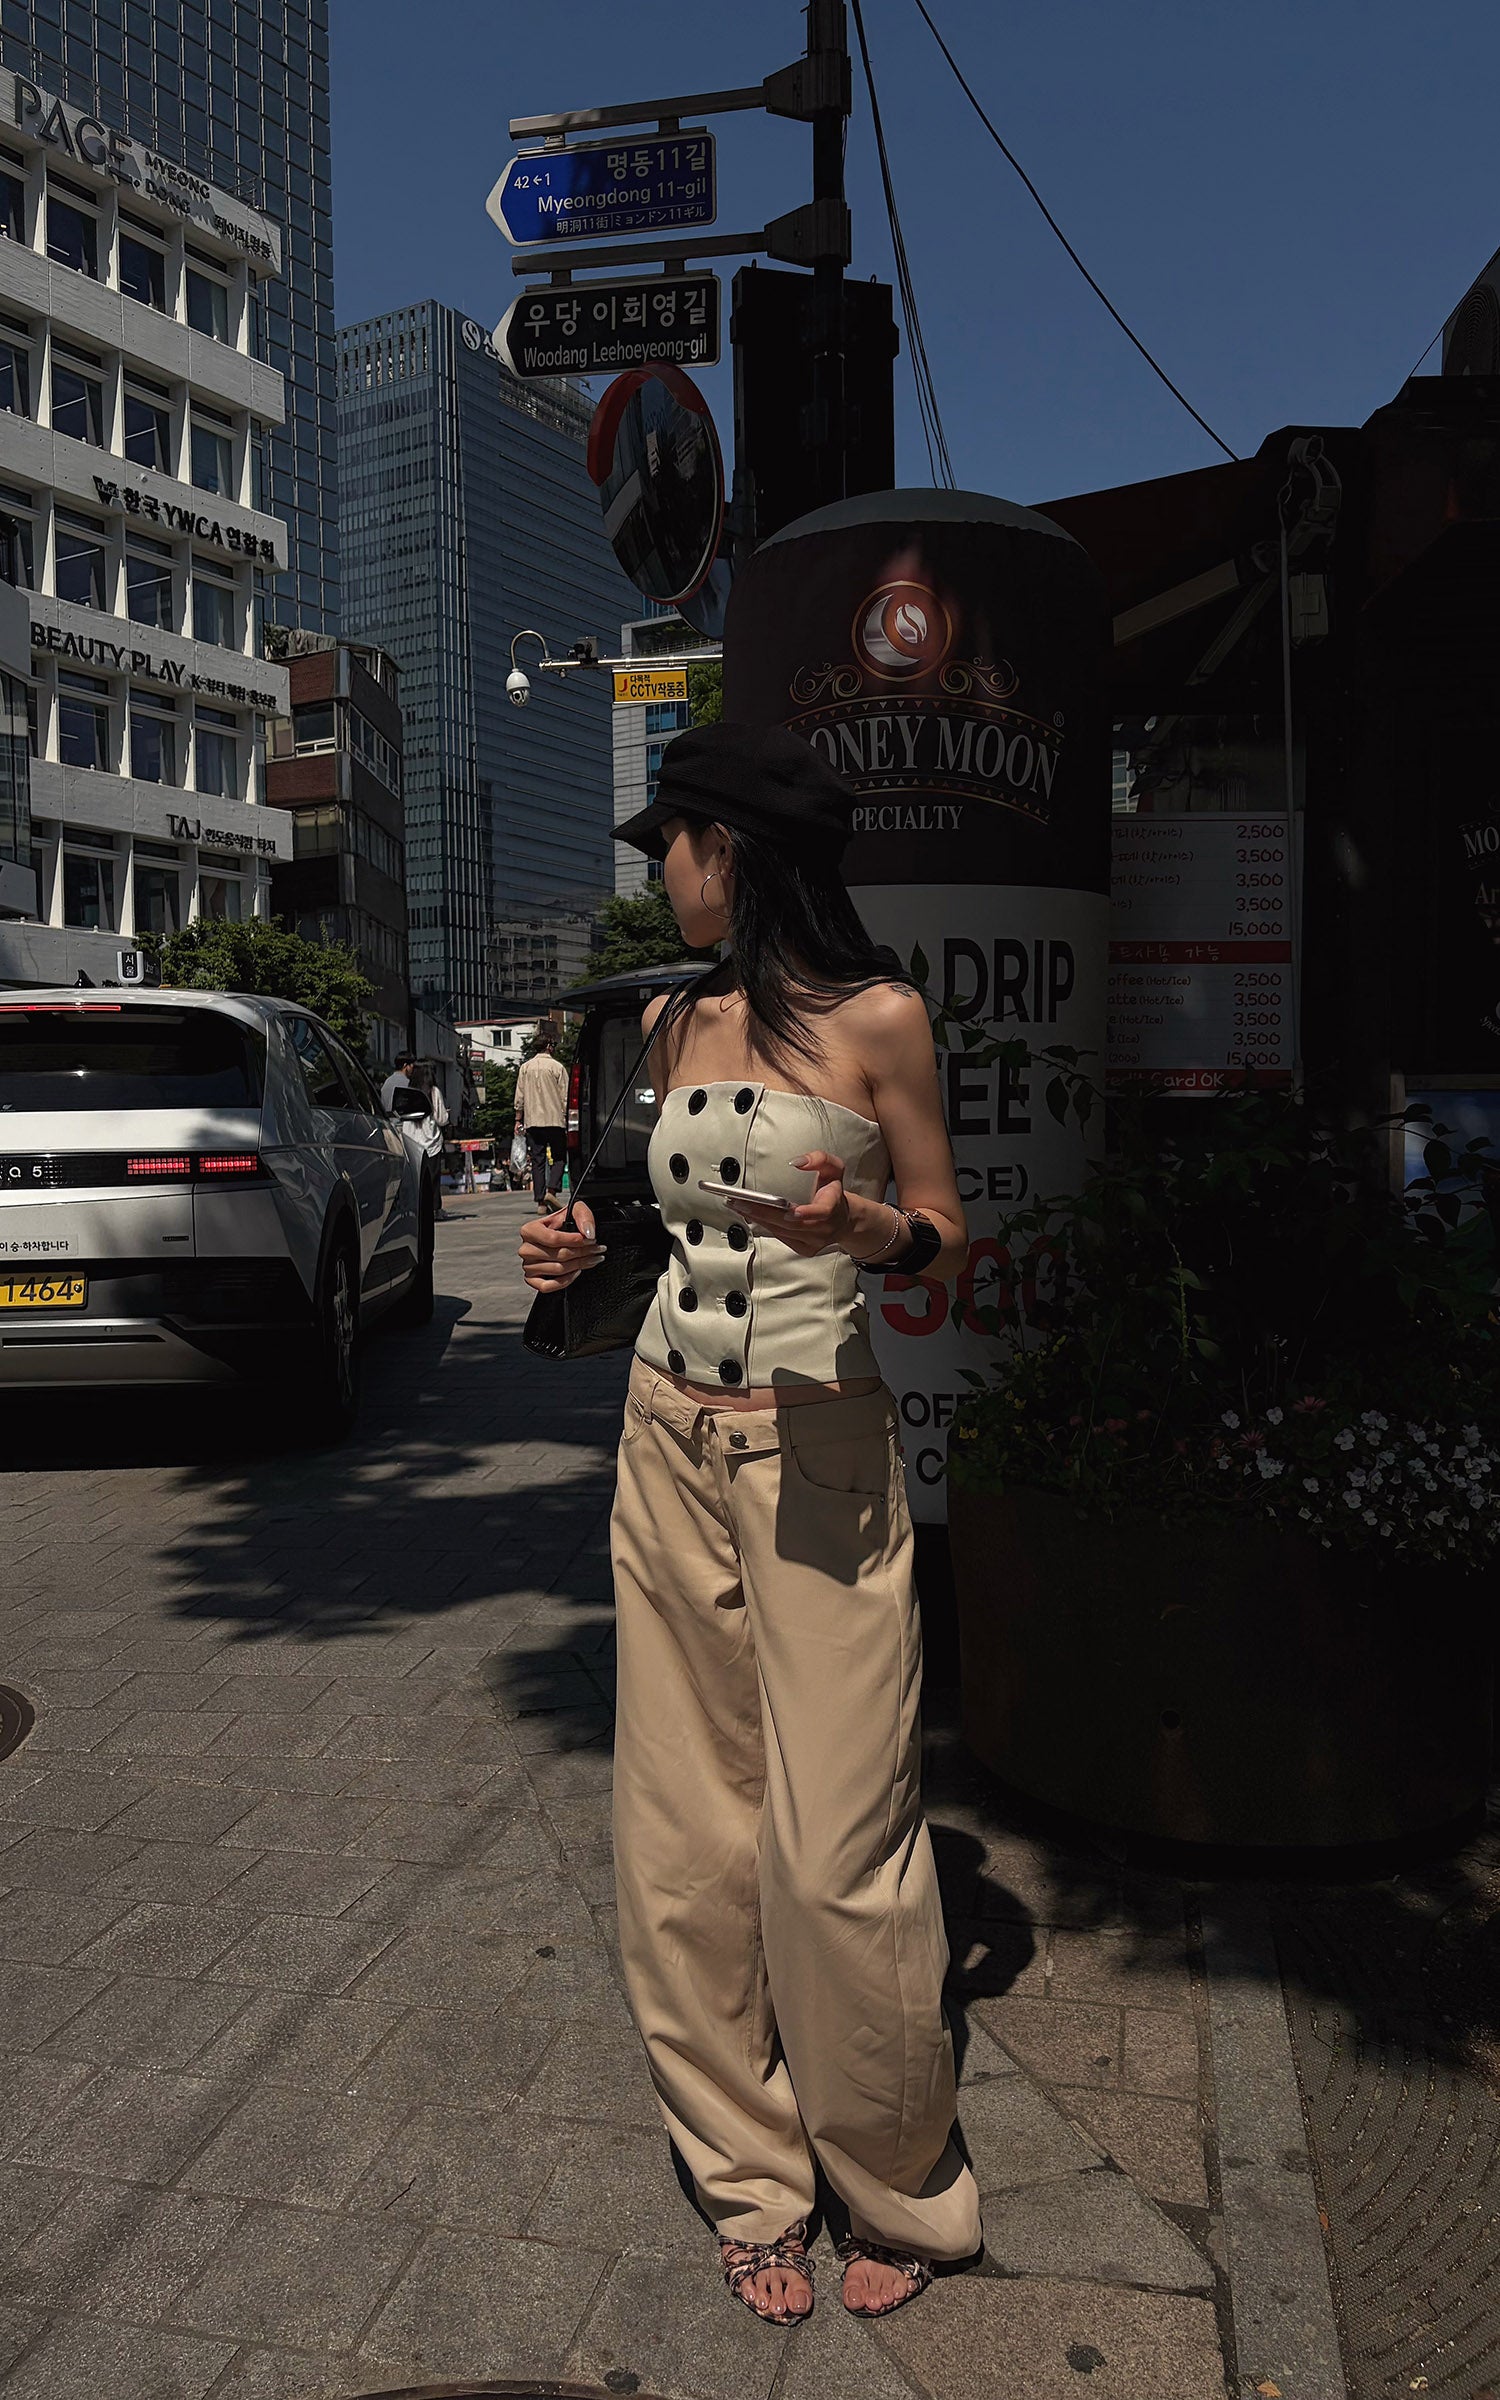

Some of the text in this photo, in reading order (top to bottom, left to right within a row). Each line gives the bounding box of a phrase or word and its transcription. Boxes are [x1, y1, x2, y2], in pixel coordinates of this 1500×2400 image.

[607, 142, 706, 181] 명동11길
[145, 151, 210, 199] MYEONG
[514, 175, 530, 190] 42
[145, 178, 190, 213] DONG
[538, 177, 707, 214] Myeongdong 11-gil
[556, 216, 608, 234] 明洞11街
[524, 288, 707, 338] 우당 이회영길
[524, 345, 588, 369] Woodang
[592, 333, 708, 363] Leehoeyeong-gil
[31, 622, 185, 687] BEAUTY PLAY
[630, 681, 685, 698] CCTV작동중
[809, 715, 1062, 800] ONEY MOON
[166, 813, 201, 840] TAJ
[852, 804, 963, 831] PECIALTY
[1236, 825, 1284, 839] 2,500
[1236, 849, 1284, 864] 3,500
[1235, 873, 1283, 888] 3,500
[1236, 897, 1283, 912] 3,500
[1228, 921, 1283, 937] 15,000
[126, 954, 136, 977] 서울
[943, 938, 1075, 1023] DRIP
[1108, 973, 1144, 986] offee
[1233, 972, 1282, 987] 2,500
[1107, 993, 1137, 1005] atte
[1233, 992, 1281, 1007] 3,500
[1232, 1012, 1281, 1027] 3,500
[1232, 1032, 1281, 1047] 3,500
[1226, 1051, 1281, 1066] 15,000
[1200, 1072, 1225, 1087] OK
[935, 1052, 1032, 1136] EE
[32, 1165, 42, 1178] 5
[954, 1165, 1028, 1202] CE)
[11, 1241, 69, 1252] 승·하차합니다
[4, 1276, 74, 1302] 1464
